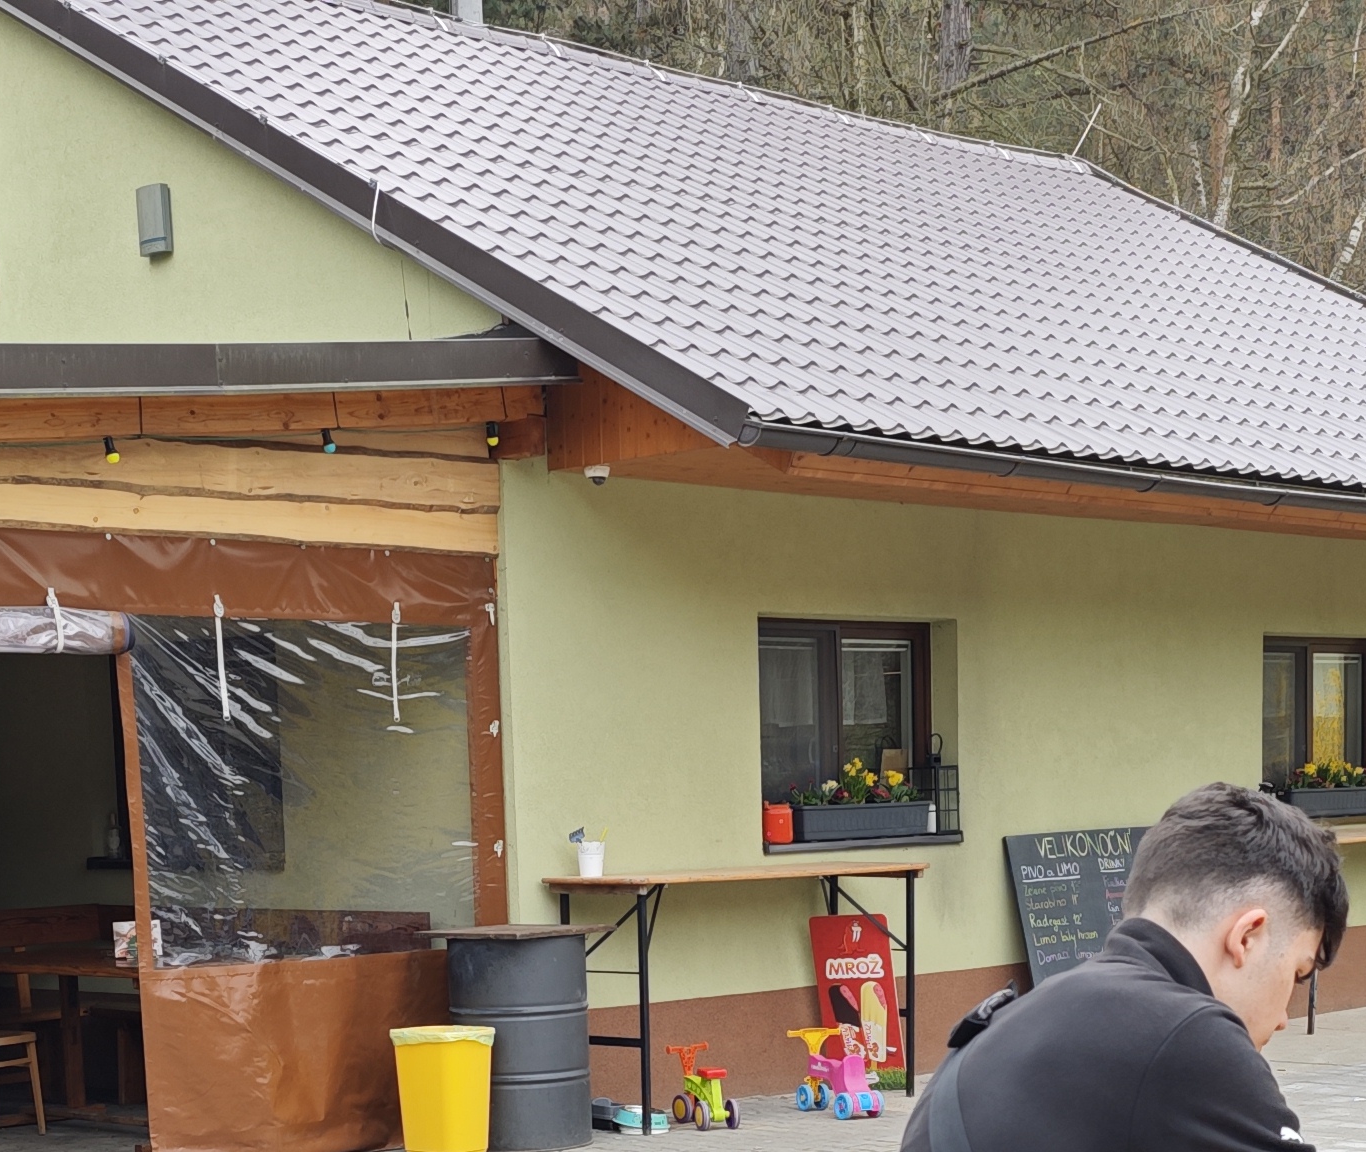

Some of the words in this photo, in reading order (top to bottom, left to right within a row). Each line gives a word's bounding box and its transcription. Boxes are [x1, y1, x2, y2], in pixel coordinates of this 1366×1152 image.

[1034, 828, 1132, 858] VELIKONOČNÍ
[1021, 865, 1044, 879] PIVO
[1046, 869, 1055, 877] a
[1056, 862, 1080, 877] LIMO
[828, 956, 881, 976] MROŽ
